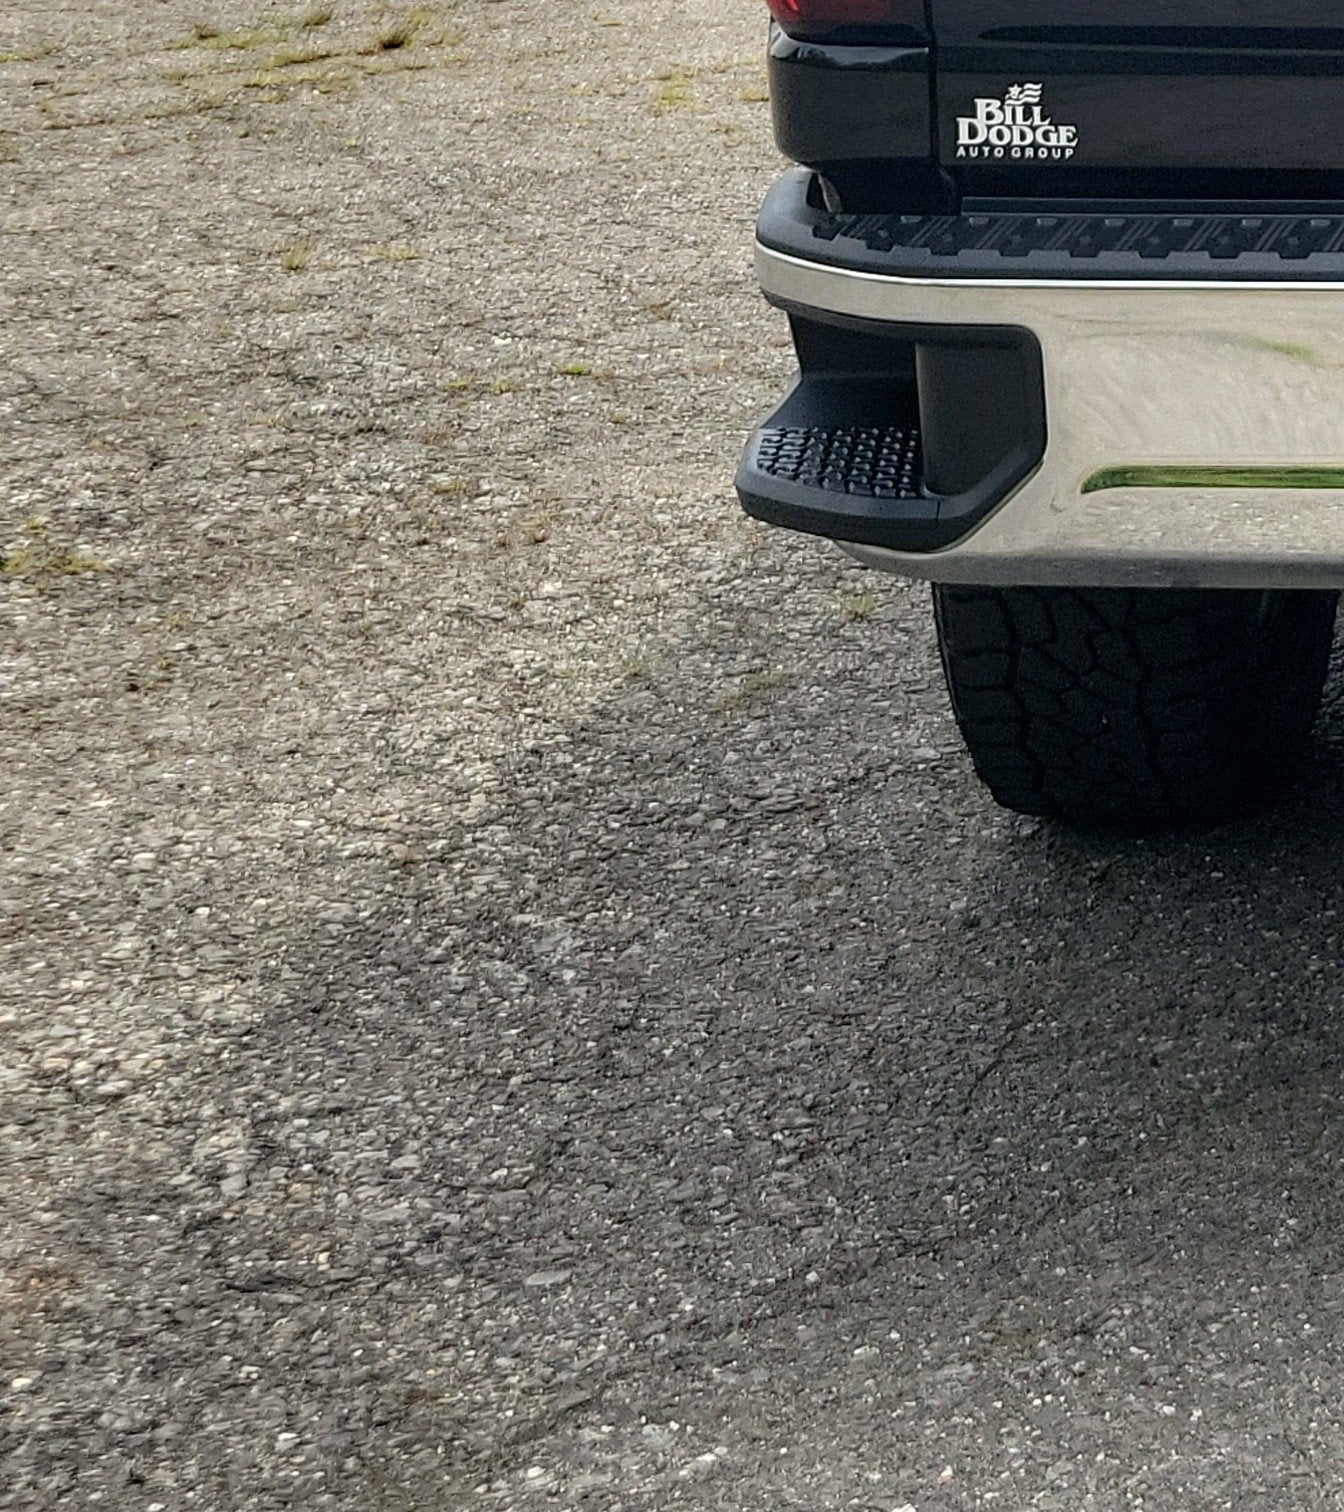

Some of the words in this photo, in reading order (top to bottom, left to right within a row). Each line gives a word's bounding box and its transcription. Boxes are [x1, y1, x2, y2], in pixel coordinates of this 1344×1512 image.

[974, 98, 1050, 126] BILL
[956, 117, 1078, 146] DODGE
[956, 146, 1004, 159] AUTO
[1011, 146, 1074, 159] GROUP
